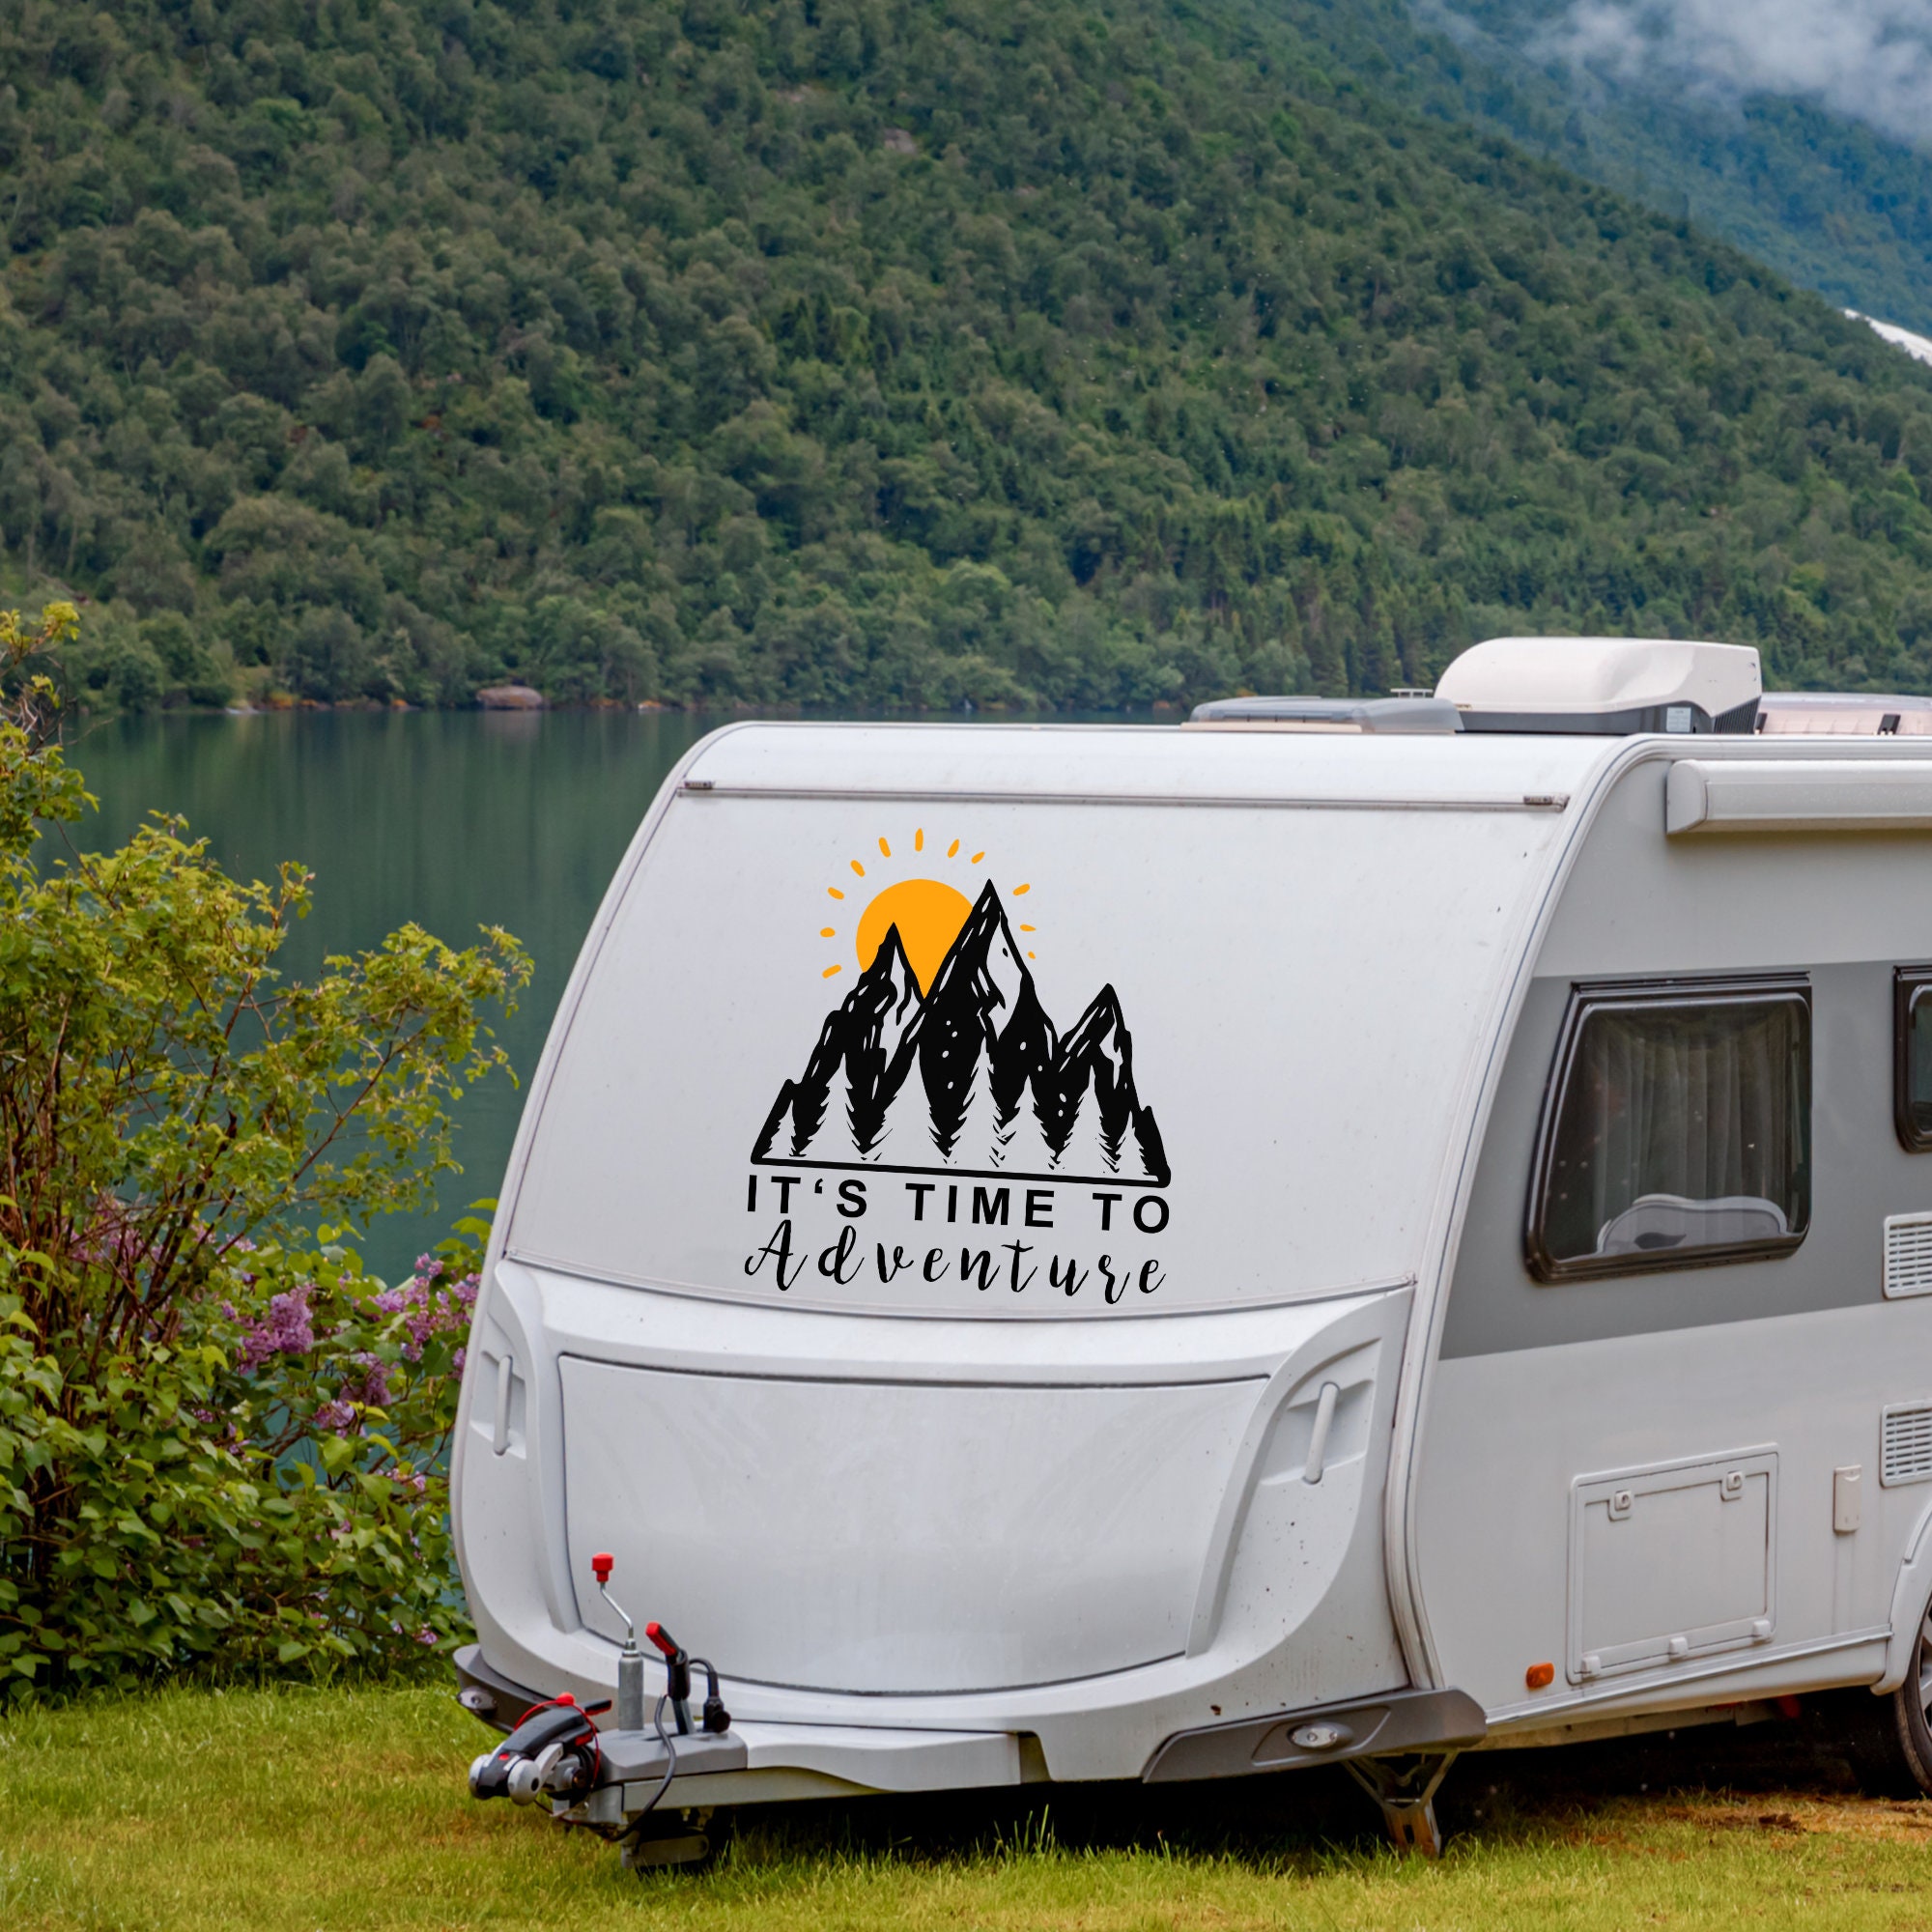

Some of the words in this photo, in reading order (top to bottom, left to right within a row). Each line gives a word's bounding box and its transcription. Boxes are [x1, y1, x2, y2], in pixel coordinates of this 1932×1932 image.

[905, 1182, 1055, 1229] TIME
[1092, 1192, 1170, 1235] TO
[744, 1219, 1167, 1305] Adventure
